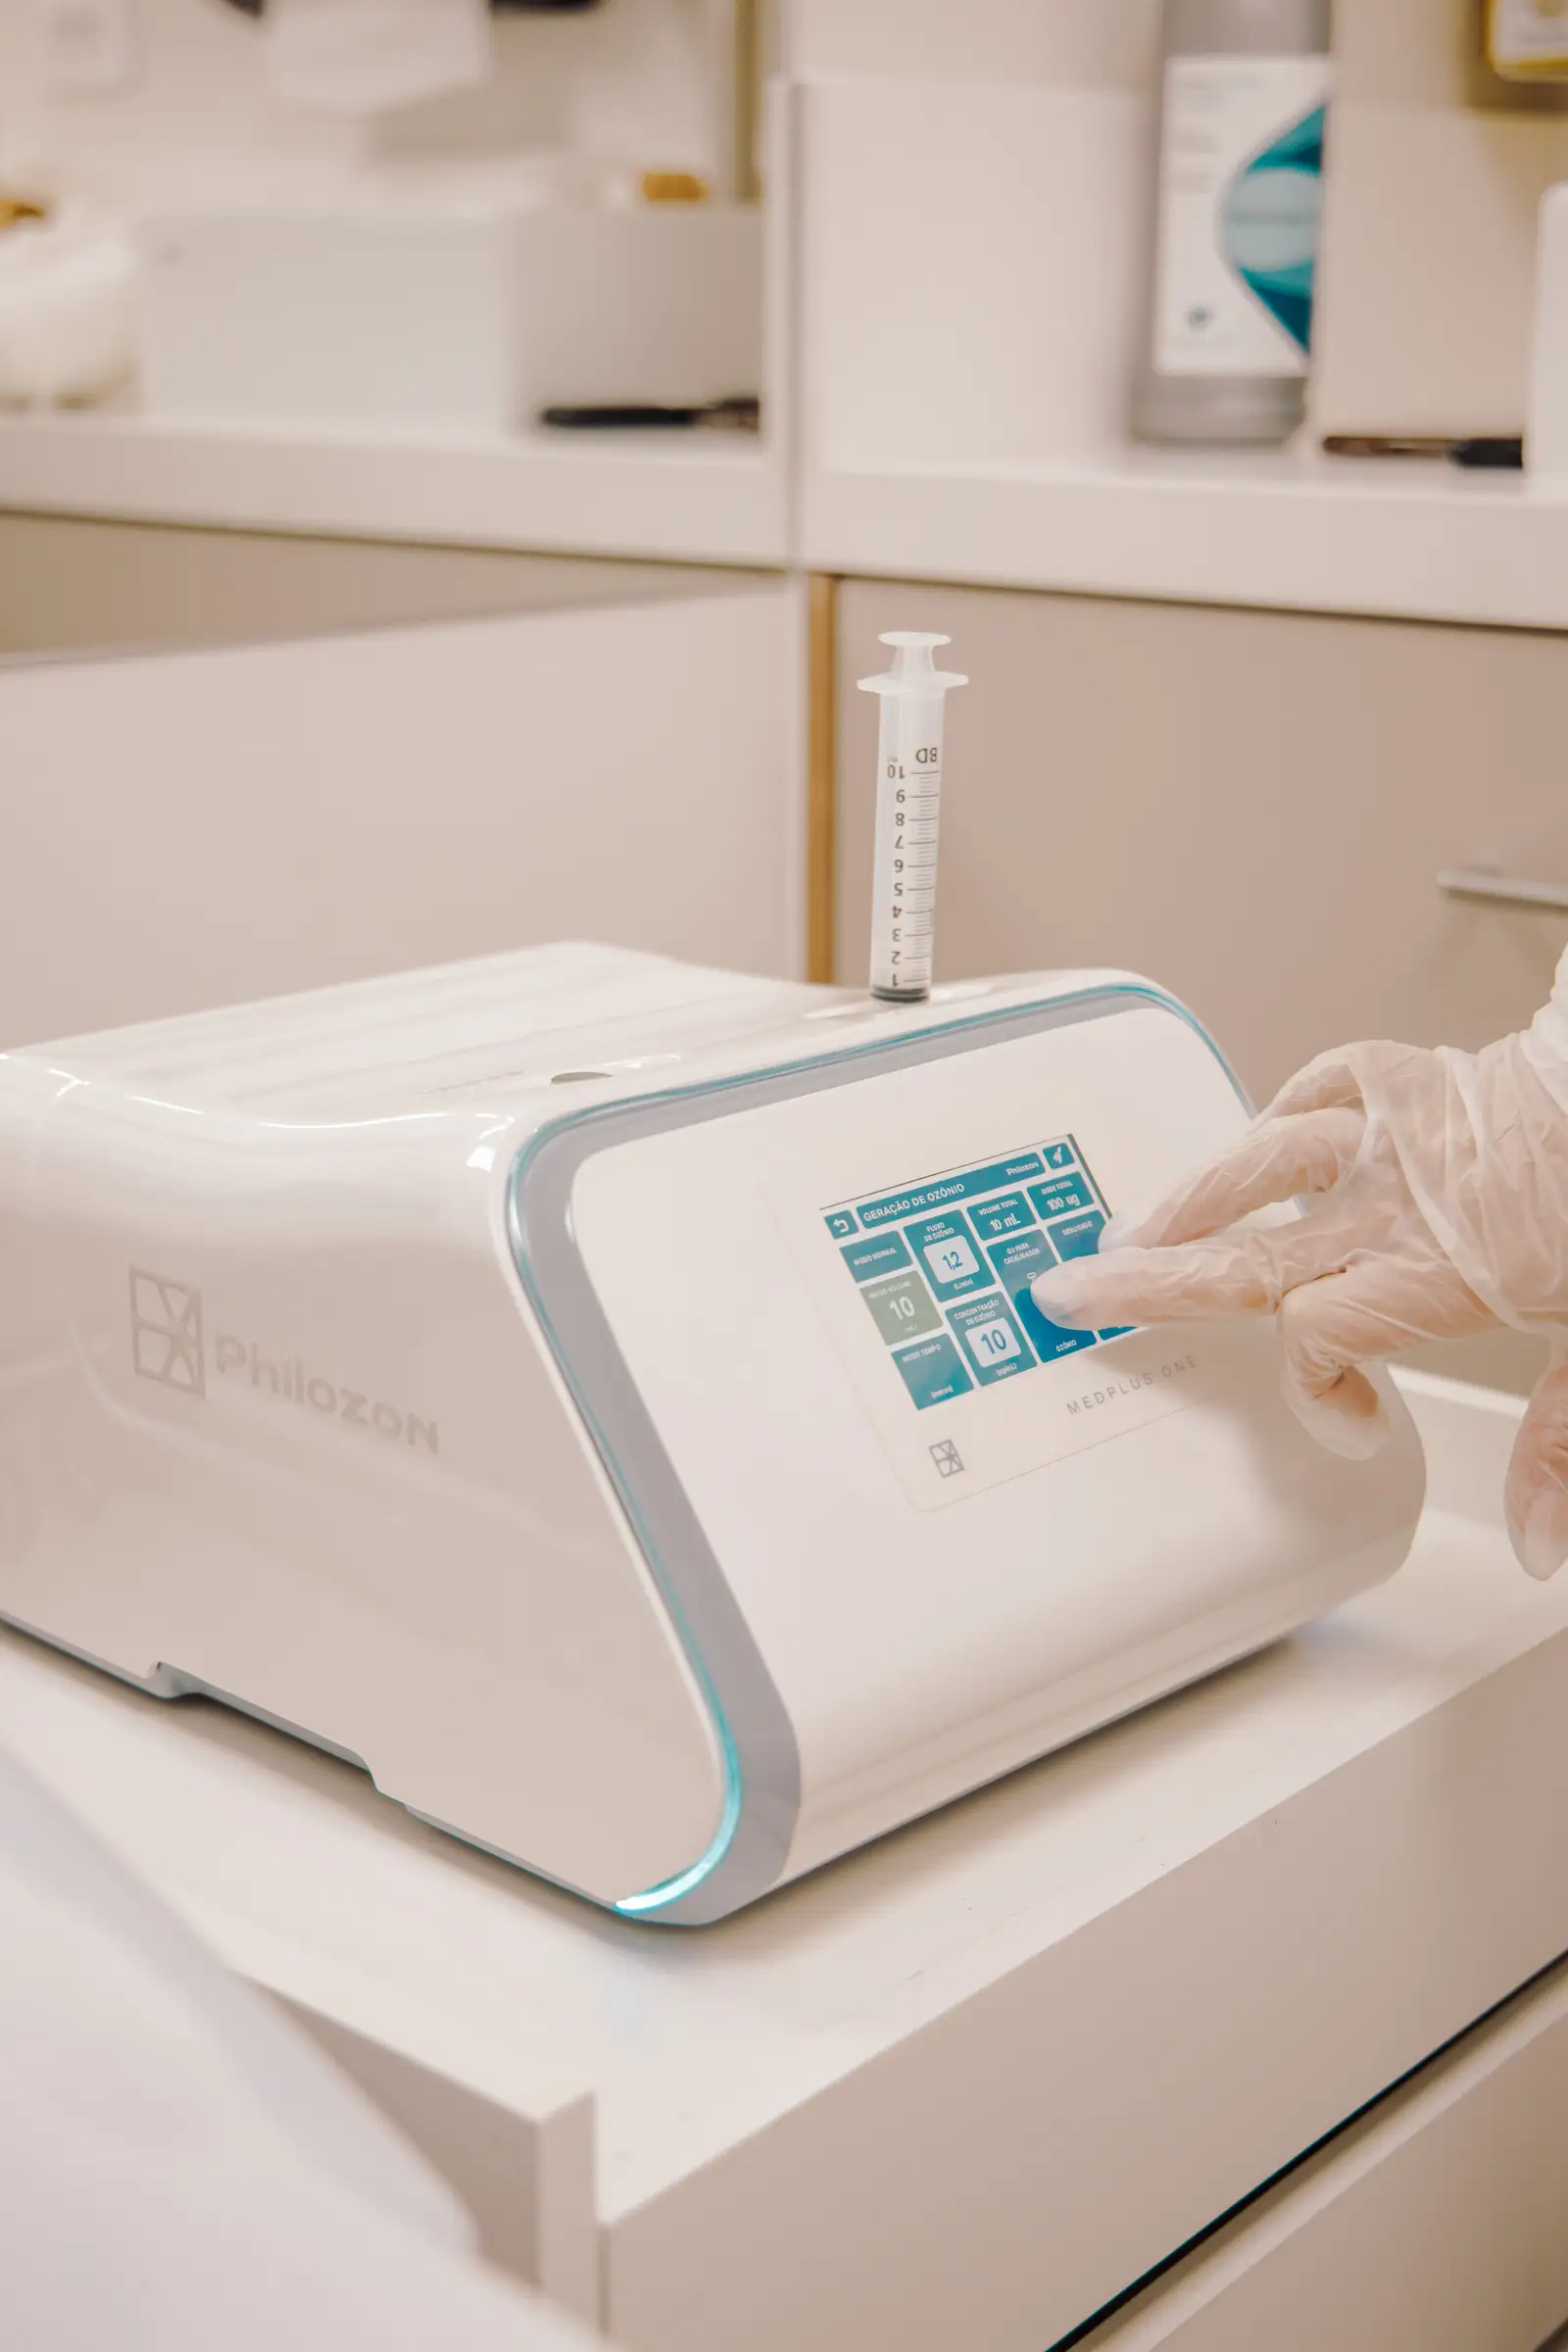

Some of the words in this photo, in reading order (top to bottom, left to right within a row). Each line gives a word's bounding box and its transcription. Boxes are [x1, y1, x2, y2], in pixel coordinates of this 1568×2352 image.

[915, 747, 938, 763] BD
[887, 764, 906, 779] 10
[896, 789, 906, 804] 9
[895, 812, 905, 826] 8
[894, 835, 906, 849] 7
[894, 859, 904, 873] 6
[894, 882, 904, 897] 5
[892, 906, 903, 919] 4
[892, 928, 902, 942] 3
[891, 951, 901, 965] 2
[892, 973, 899, 988] 1
[1056, 1180, 1073, 1191] TOTAL
[863, 1200, 910, 1221] GERAÇÃO
[911, 1195, 926, 1206] DE
[927, 1183, 965, 1201] OZÔNIO
[978, 1203, 1001, 1215] VOLUME
[1002, 1199, 1018, 1209] TOTAL
[1047, 1197, 1064, 1211] 100
[1066, 1194, 1080, 1206] ug
[926, 1222, 945, 1233] FLUXO
[990, 1219, 1002, 1231] 10
[1004, 1213, 1021, 1227] mL
[924, 1233, 933, 1242] DE
[933, 1228, 955, 1240] OZÔNIO
[853, 1252, 872, 1265] MODO
[872, 1247, 898, 1260] NORMAL
[942, 1250, 963, 1271] 1,2
[1004, 1248, 1041, 1265] CATALISADOR
[889, 1296, 915, 1320] 10
[954, 1299, 1000, 1320] CONCENTRAÇÃO
[981, 1328, 1006, 1354] 10
[1055, 1339, 1077, 1352] OZÔNIO
[920, 1344, 942, 1357] TEMPO
[1066, 1373, 1153, 1415] MEDPLUS
[1160, 1354, 1197, 1378] ONE
